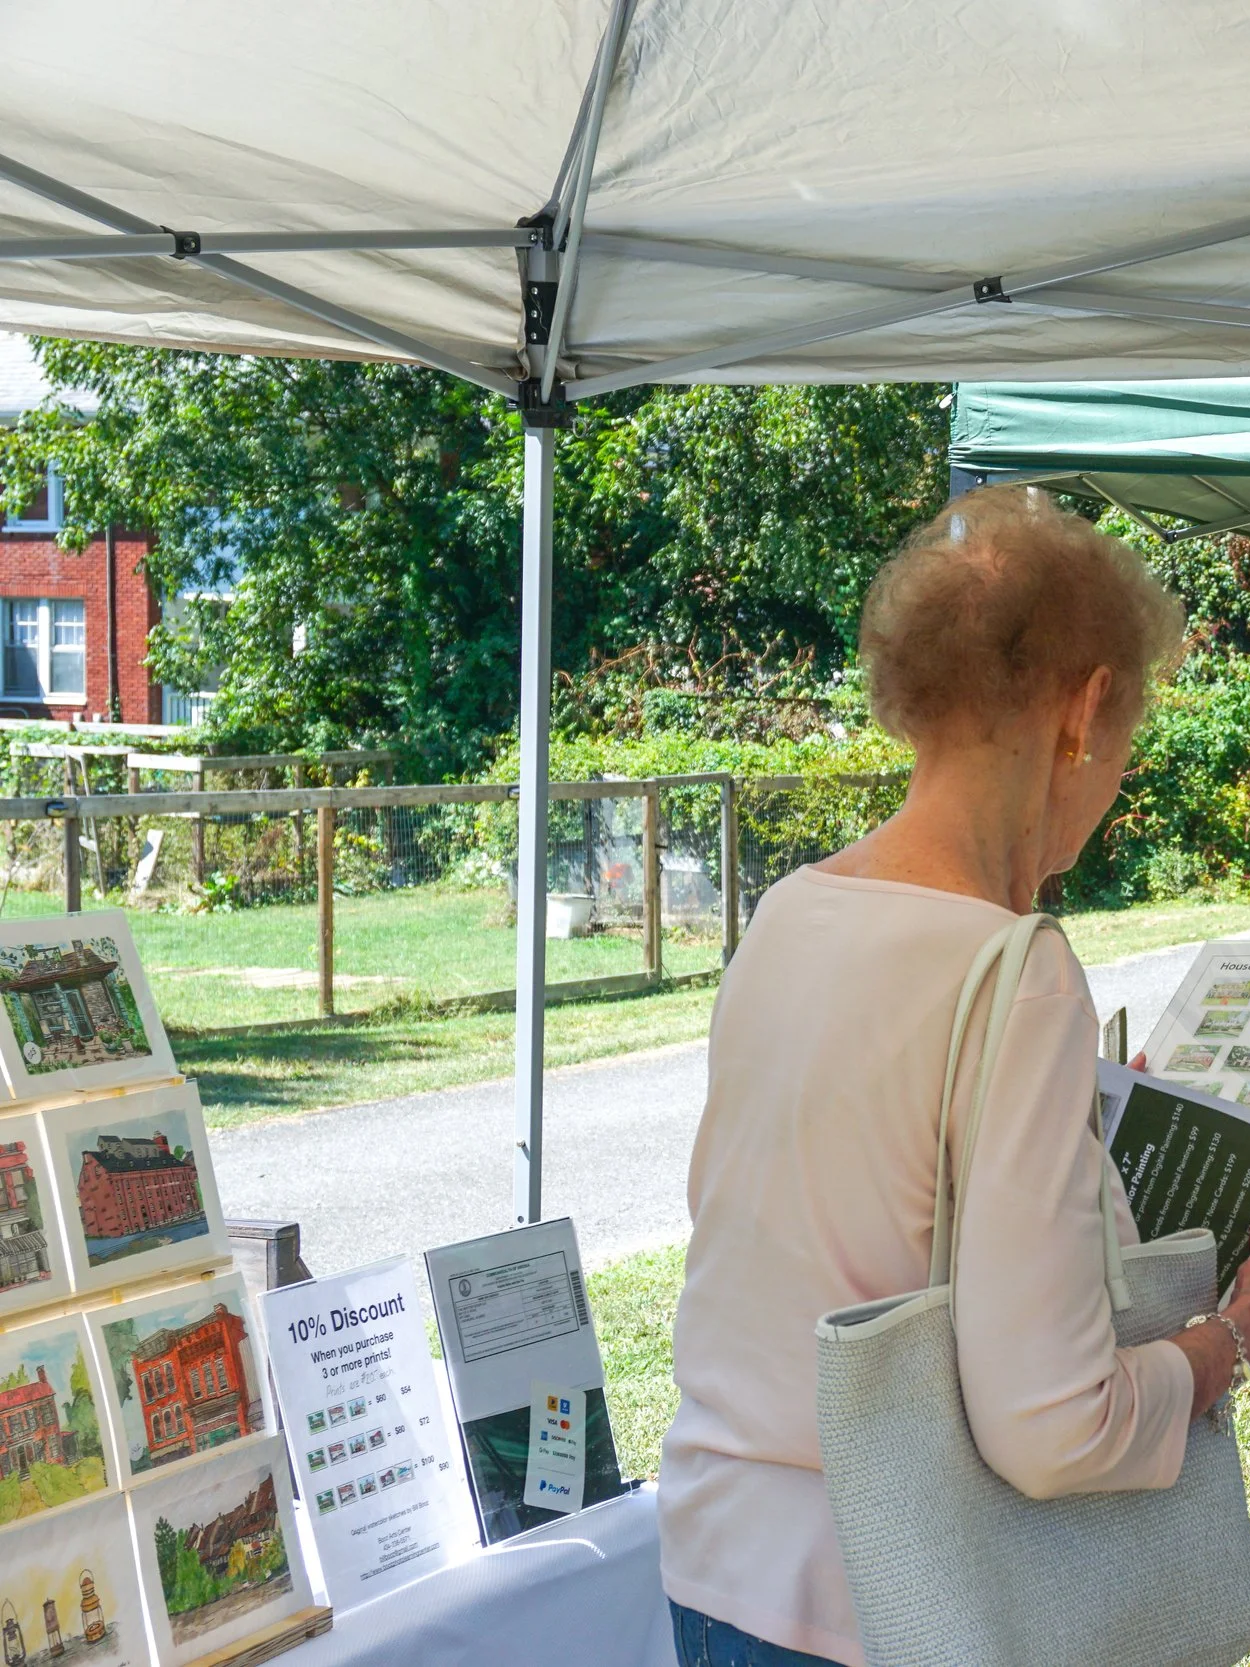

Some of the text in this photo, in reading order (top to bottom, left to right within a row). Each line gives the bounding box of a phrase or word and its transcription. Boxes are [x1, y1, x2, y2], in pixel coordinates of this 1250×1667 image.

[1132, 1144, 1155, 1184] Painting
[1144, 1177, 1156, 1194] from
[1151, 1152, 1165, 1176] Digital
[1161, 1123, 1177, 1152] Painting:
[1172, 1104, 1183, 1121] $140
[1151, 1126, 1199, 1237] Cards from Digital Painting: $99
[1178, 1210, 1190, 1226] from
[1186, 1184, 1200, 1208] Digital
[1196, 1153, 1214, 1184] Painting:
[1209, 1132, 1221, 1152] $130
[1206, 1199, 1218, 1216] Note
[1214, 1174, 1228, 1197] Cards:
[1224, 1154, 1236, 1173] $199
[1224, 1219, 1233, 1233] Use
[1230, 1189, 1246, 1218] License:
[288, 1293, 405, 1343] 10% Discount
[311, 1332, 394, 1363] When you purchase
[322, 1348, 392, 1379] 3 or more prints!
[376, 1393, 387, 1403] $60
[419, 1416, 430, 1426] $72
[421, 1455, 435, 1466] $100
[439, 1461, 449, 1471] $90
[548, 1483, 570, 1495] PayPal
